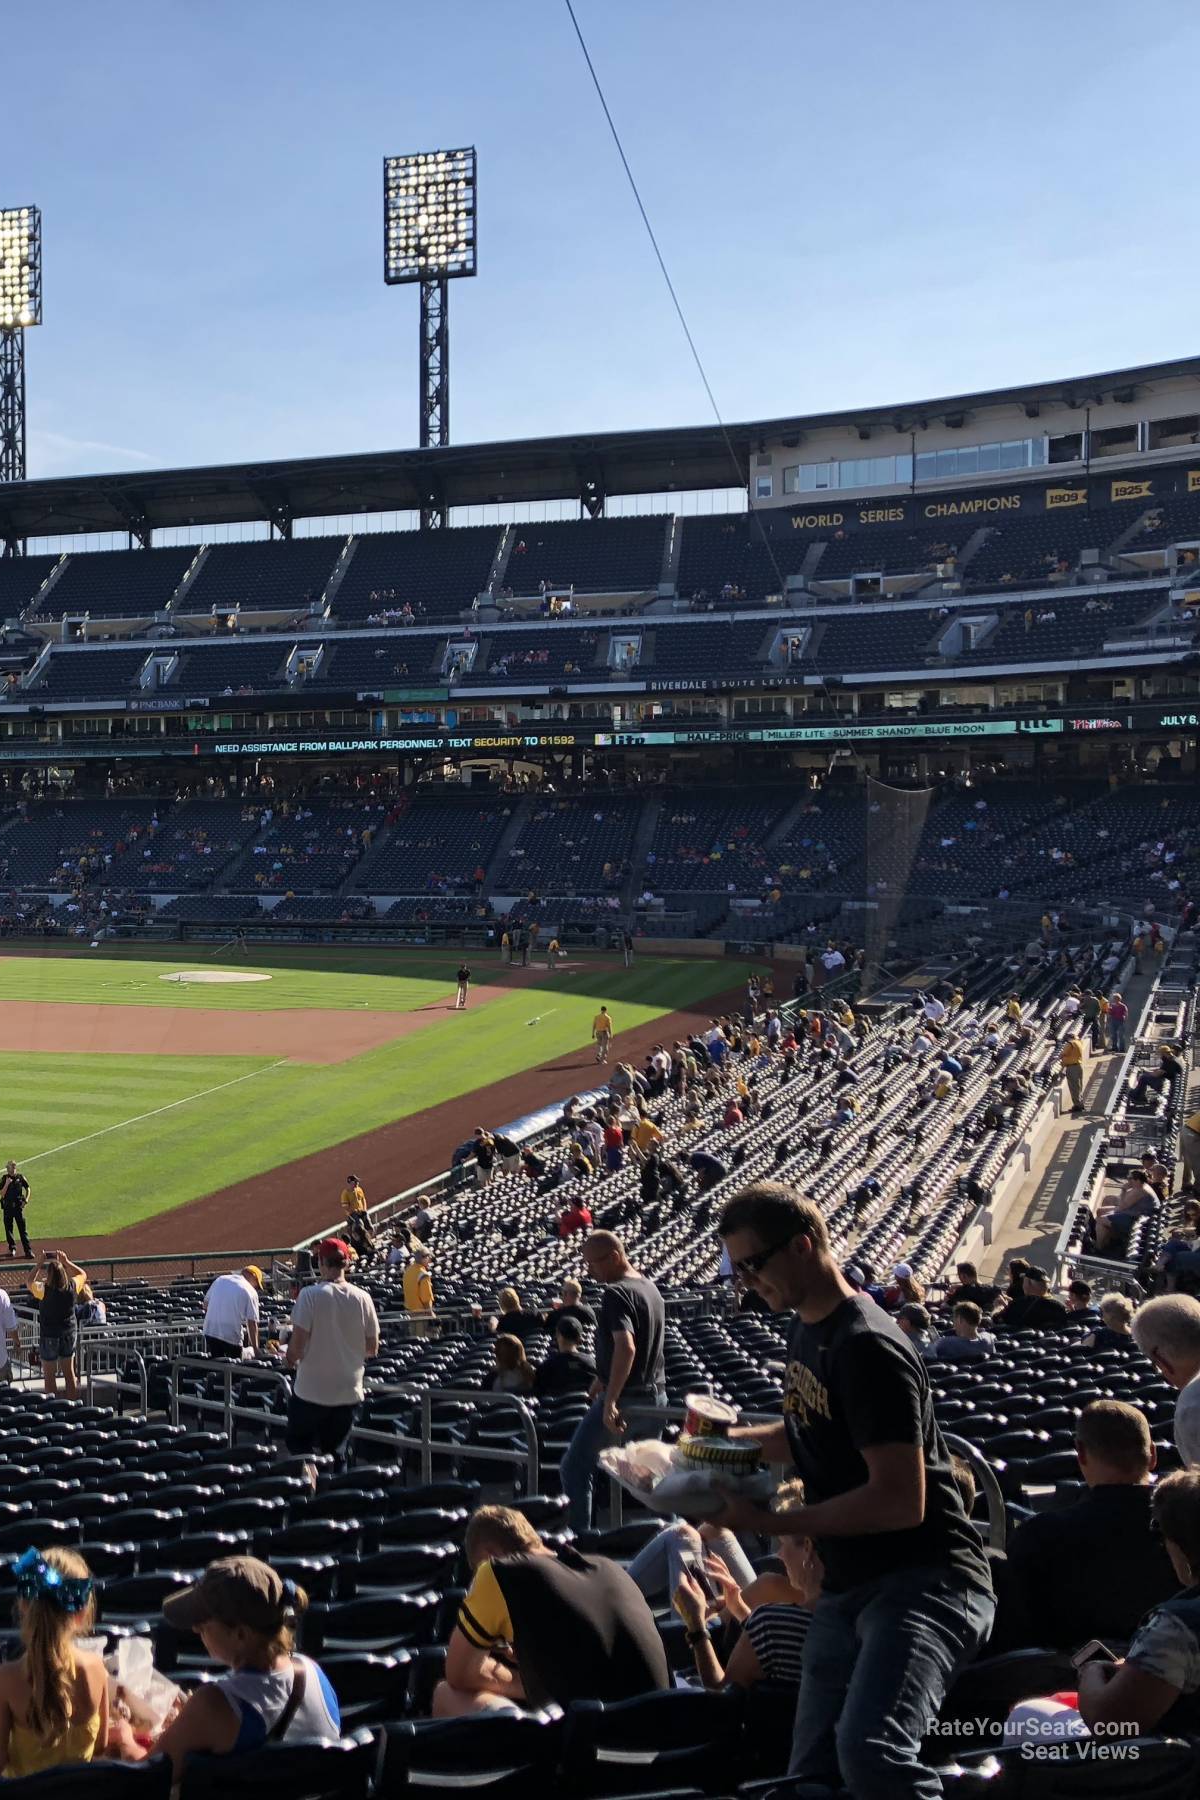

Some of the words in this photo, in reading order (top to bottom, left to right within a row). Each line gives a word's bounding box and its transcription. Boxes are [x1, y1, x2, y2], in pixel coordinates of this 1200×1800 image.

[1114, 486, 1143, 497] 1925
[1049, 492, 1079, 504] 1909
[791, 513, 844, 529] WORLD
[859, 508, 905, 524] SERIES
[924, 495, 1021, 518] CHAMPIONS
[721, 679, 755, 687] SUITE
[762, 678, 799, 686] LEVEL
[1161, 715, 1186, 726] JULY
[767, 729, 802, 739] MILLER
[804, 729, 825, 738] LITE
[832, 728, 874, 738] SUMMER
[876, 727, 917, 736] SHANDY
[924, 725, 951, 735] BLUE
[953, 724, 985, 733] MOON
[215, 744, 239, 753] NEED
[241, 743, 298, 752] ASSISTANCE
[300, 742, 327, 751] FROM
[329, 740, 378, 750] BALLPARK
[380, 738, 444, 749] PERSONNEL?
[448, 738, 472, 747] TEXT
[474, 737, 523, 746] SECURITY
[525, 736, 538, 745] TO
[540, 735, 575, 745] 61592
